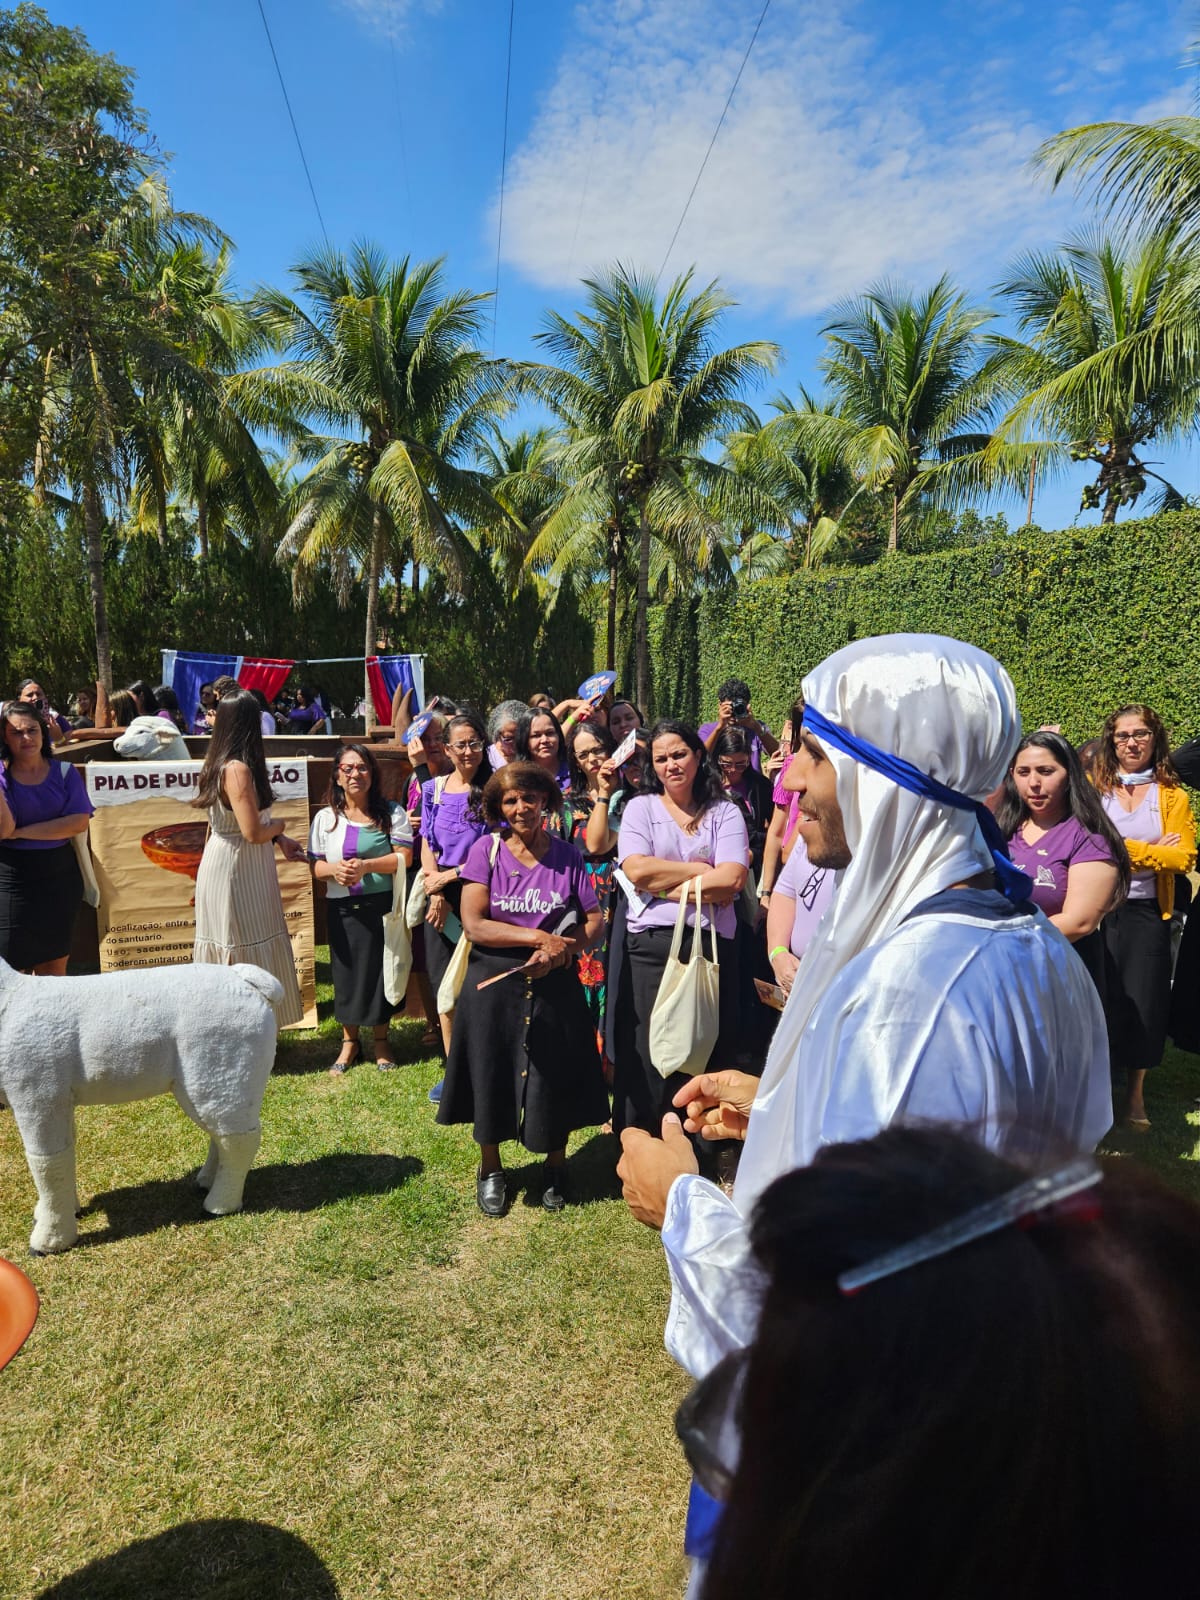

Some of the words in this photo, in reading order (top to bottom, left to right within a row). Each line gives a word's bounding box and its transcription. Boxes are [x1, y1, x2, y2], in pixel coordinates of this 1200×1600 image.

[94, 775, 129, 791] PIA
[133, 773, 161, 789] DE
[492, 888, 564, 914] mulher
[165, 920, 189, 928] entre
[136, 943, 195, 954] sacerdotes
[107, 959, 148, 968] poderem
[148, 956, 176, 964] entrar
